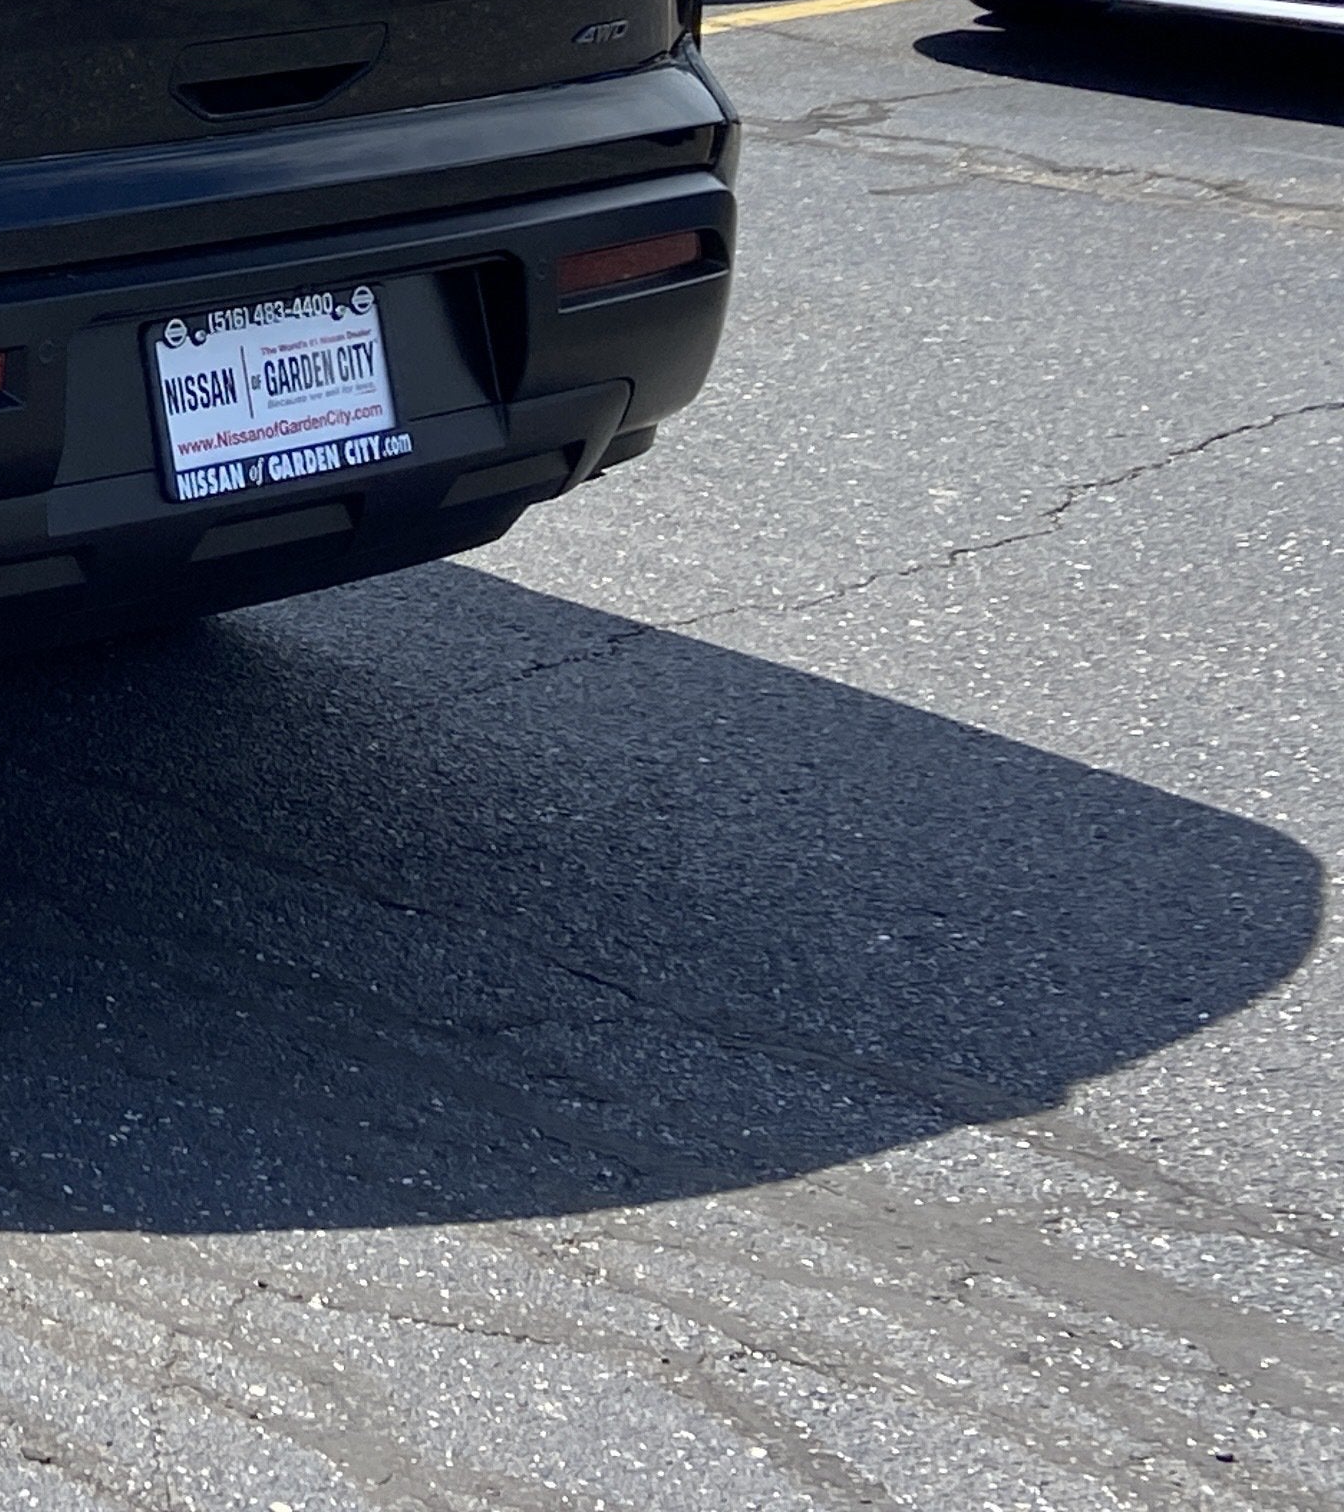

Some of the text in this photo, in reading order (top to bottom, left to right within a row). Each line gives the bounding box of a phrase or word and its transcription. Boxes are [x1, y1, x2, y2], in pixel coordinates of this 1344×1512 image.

[573, 19, 629, 44] 4WD
[253, 292, 333, 326] 483-4400
[164, 367, 238, 416] NISSAN
[251, 341, 376, 397] OF GARDEN CITY
[178, 403, 383, 456] www.NissanofGardenCity.com
[176, 432, 412, 501] NISSAN of GARDEN CITY.com
